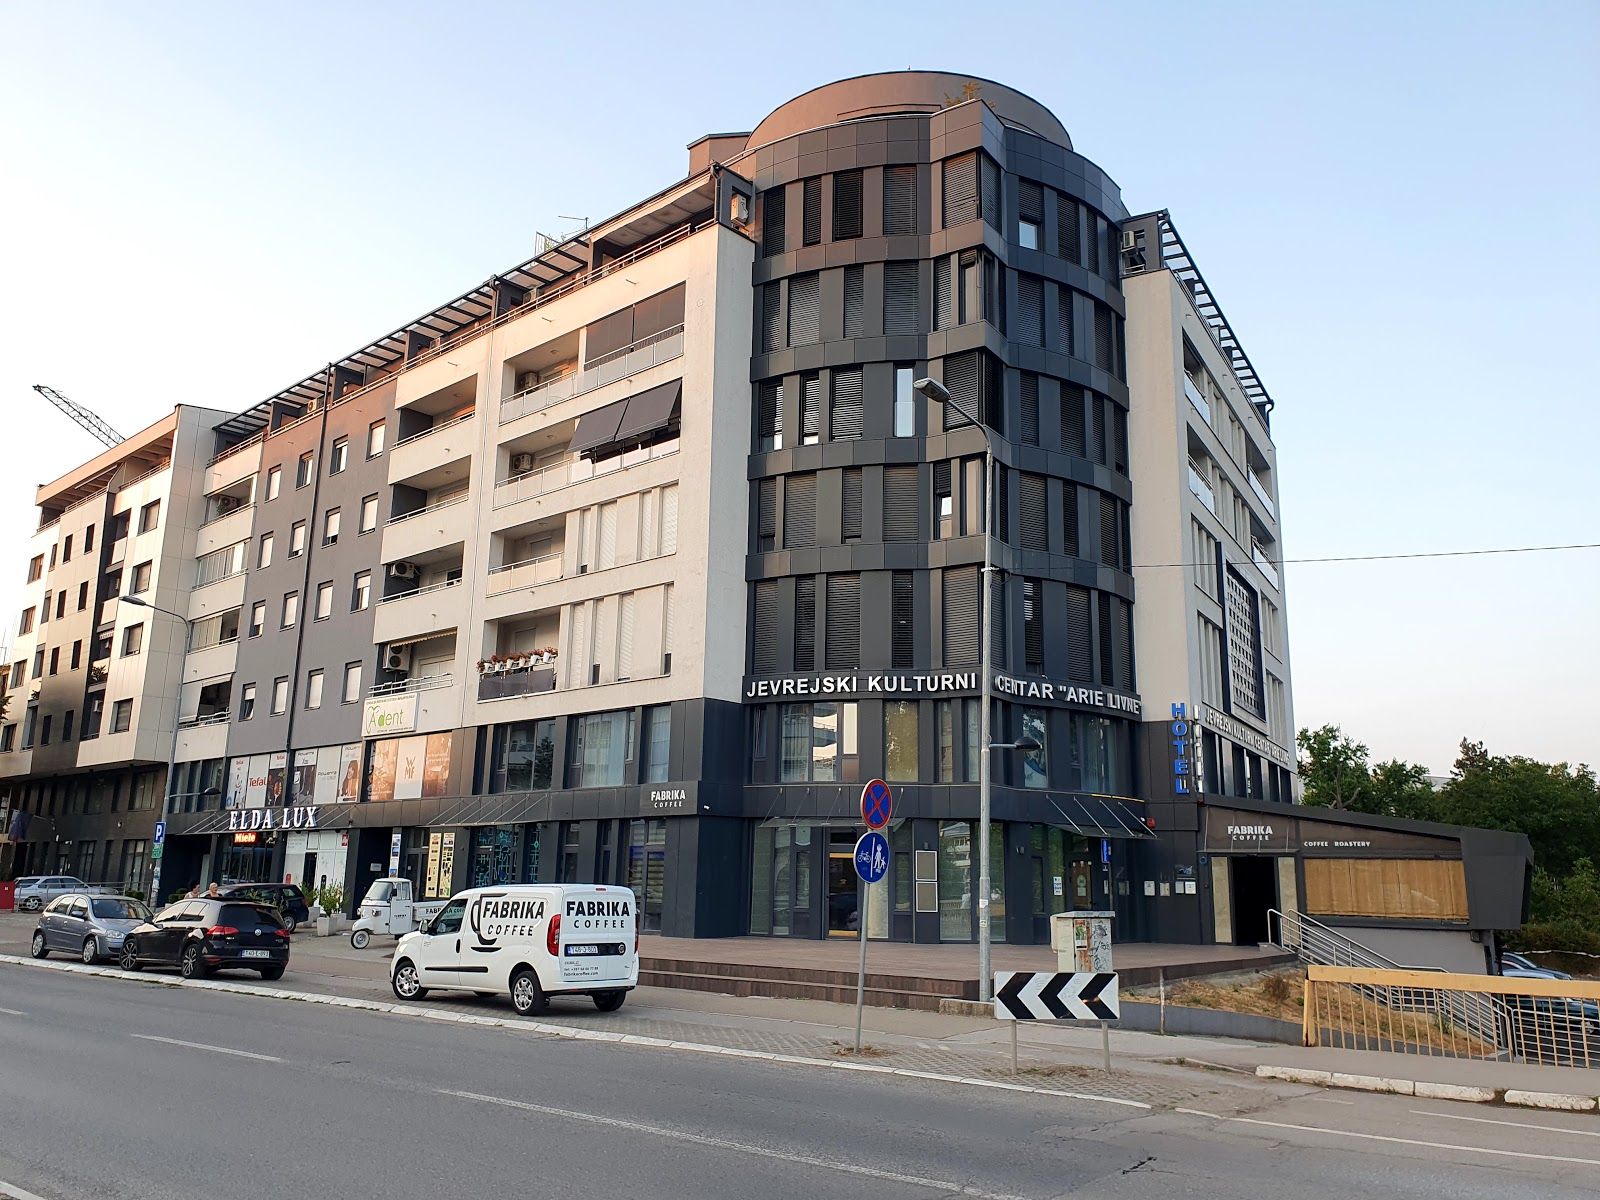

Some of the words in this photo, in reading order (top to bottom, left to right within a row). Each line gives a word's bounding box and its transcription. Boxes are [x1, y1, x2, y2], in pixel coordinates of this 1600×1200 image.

[746, 676, 857, 697] JEVREJSKI
[868, 672, 976, 692] KULTURNI
[995, 674, 1054, 700] CENTAR
[1171, 702, 1190, 795] HOTEL
[249, 776, 267, 787] Tefal
[651, 790, 686, 801] FABRIKA
[229, 808, 274, 830] ELDA
[282, 806, 317, 828] LUX
[155, 825, 163, 841] P
[1227, 825, 1273, 835] FABRIKA
[234, 832, 257, 843] Miele
[482, 901, 546, 919] FABRIKA
[566, 901, 630, 917] FABRIKA
[487, 924, 534, 936] COFFEE
[574, 919, 625, 929] COFFEE
